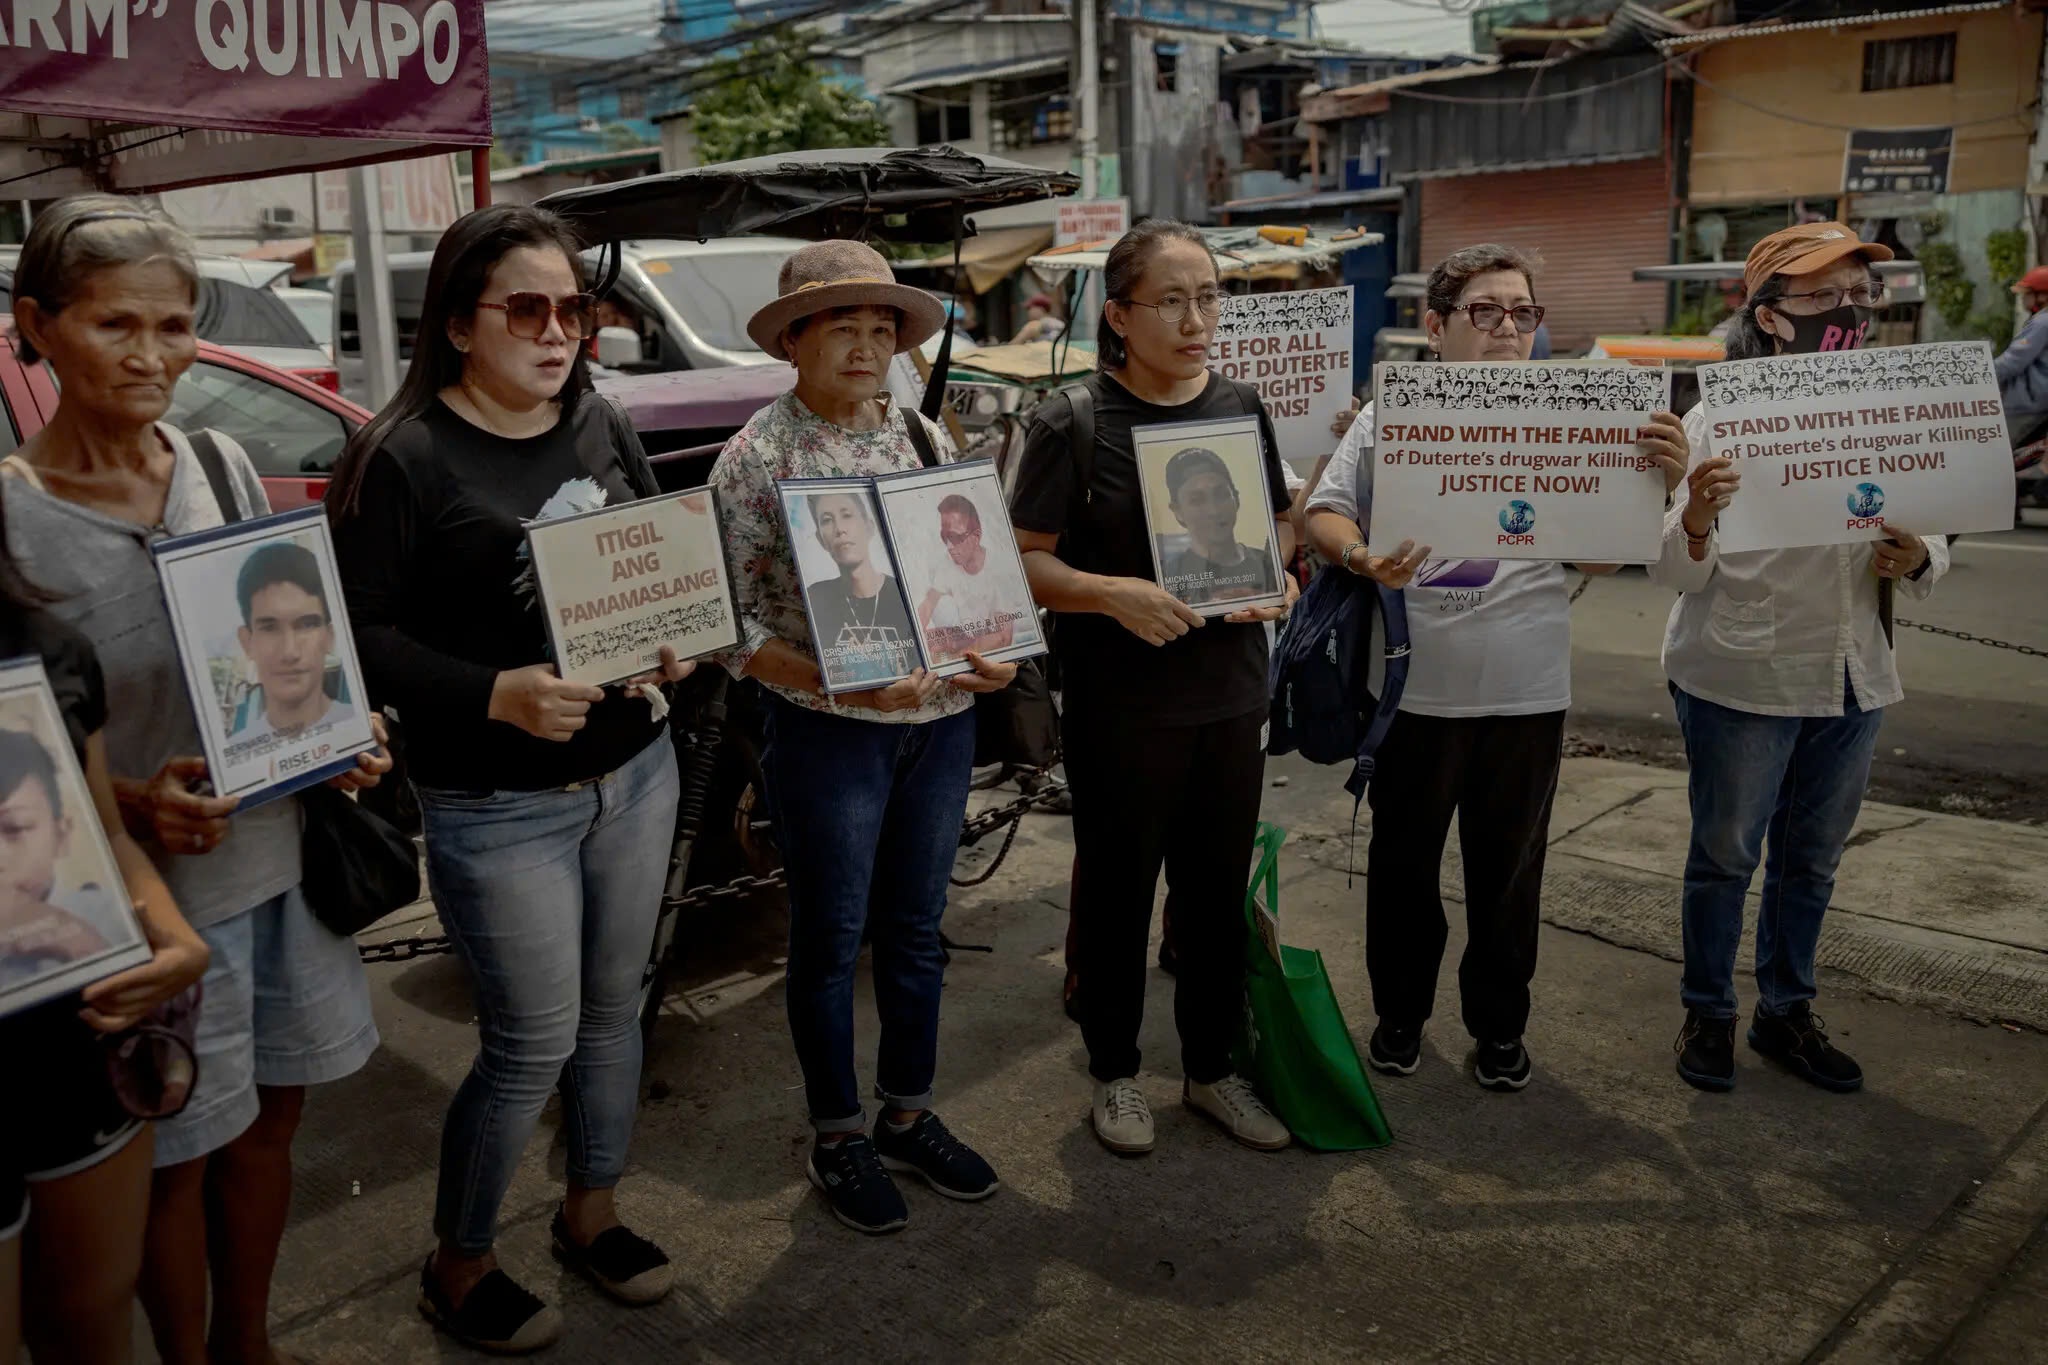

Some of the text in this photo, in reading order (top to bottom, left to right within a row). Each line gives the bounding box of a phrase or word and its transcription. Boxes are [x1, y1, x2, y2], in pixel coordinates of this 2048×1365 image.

[195, 0, 460, 85] QUIMPO
[1238, 337, 1281, 358] FOR
[1287, 333, 1326, 353] ALL
[1222, 351, 1349, 380] OF DUTERTE
[1713, 399, 2001, 439] STAND WITH THE FAMILIES
[1381, 424, 1667, 444] STAND WITH THE FAMILI
[1721, 424, 2002, 459] of Duterte’s drugwar Killings!
[1384, 450, 1405, 465] of
[1408, 451, 1494, 466] Duterte’s
[1499, 451, 1582, 470] drugwar
[1781, 451, 1946, 486] JUSTICE NOW!
[1438, 474, 1600, 496] JUSTICE NOW!
[1847, 517, 1885, 530] PCPR
[595, 521, 664, 556] ITIGIL
[1497, 534, 1535, 546] PCPR
[611, 552, 660, 582] ANG
[1165, 571, 1214, 585] MICHAEL LEE
[1241, 574, 1256, 582] 2017
[559, 568, 719, 627] PAMAMASLANG!
[1444, 591, 1486, 601] AWIT
[926, 611, 1023, 640] JUAN CARLOS C. B. LOZANO
[884, 638, 914, 649] LOZANO
[826, 657, 839, 666] DATE
[277, 743, 332, 771] RISE UP
